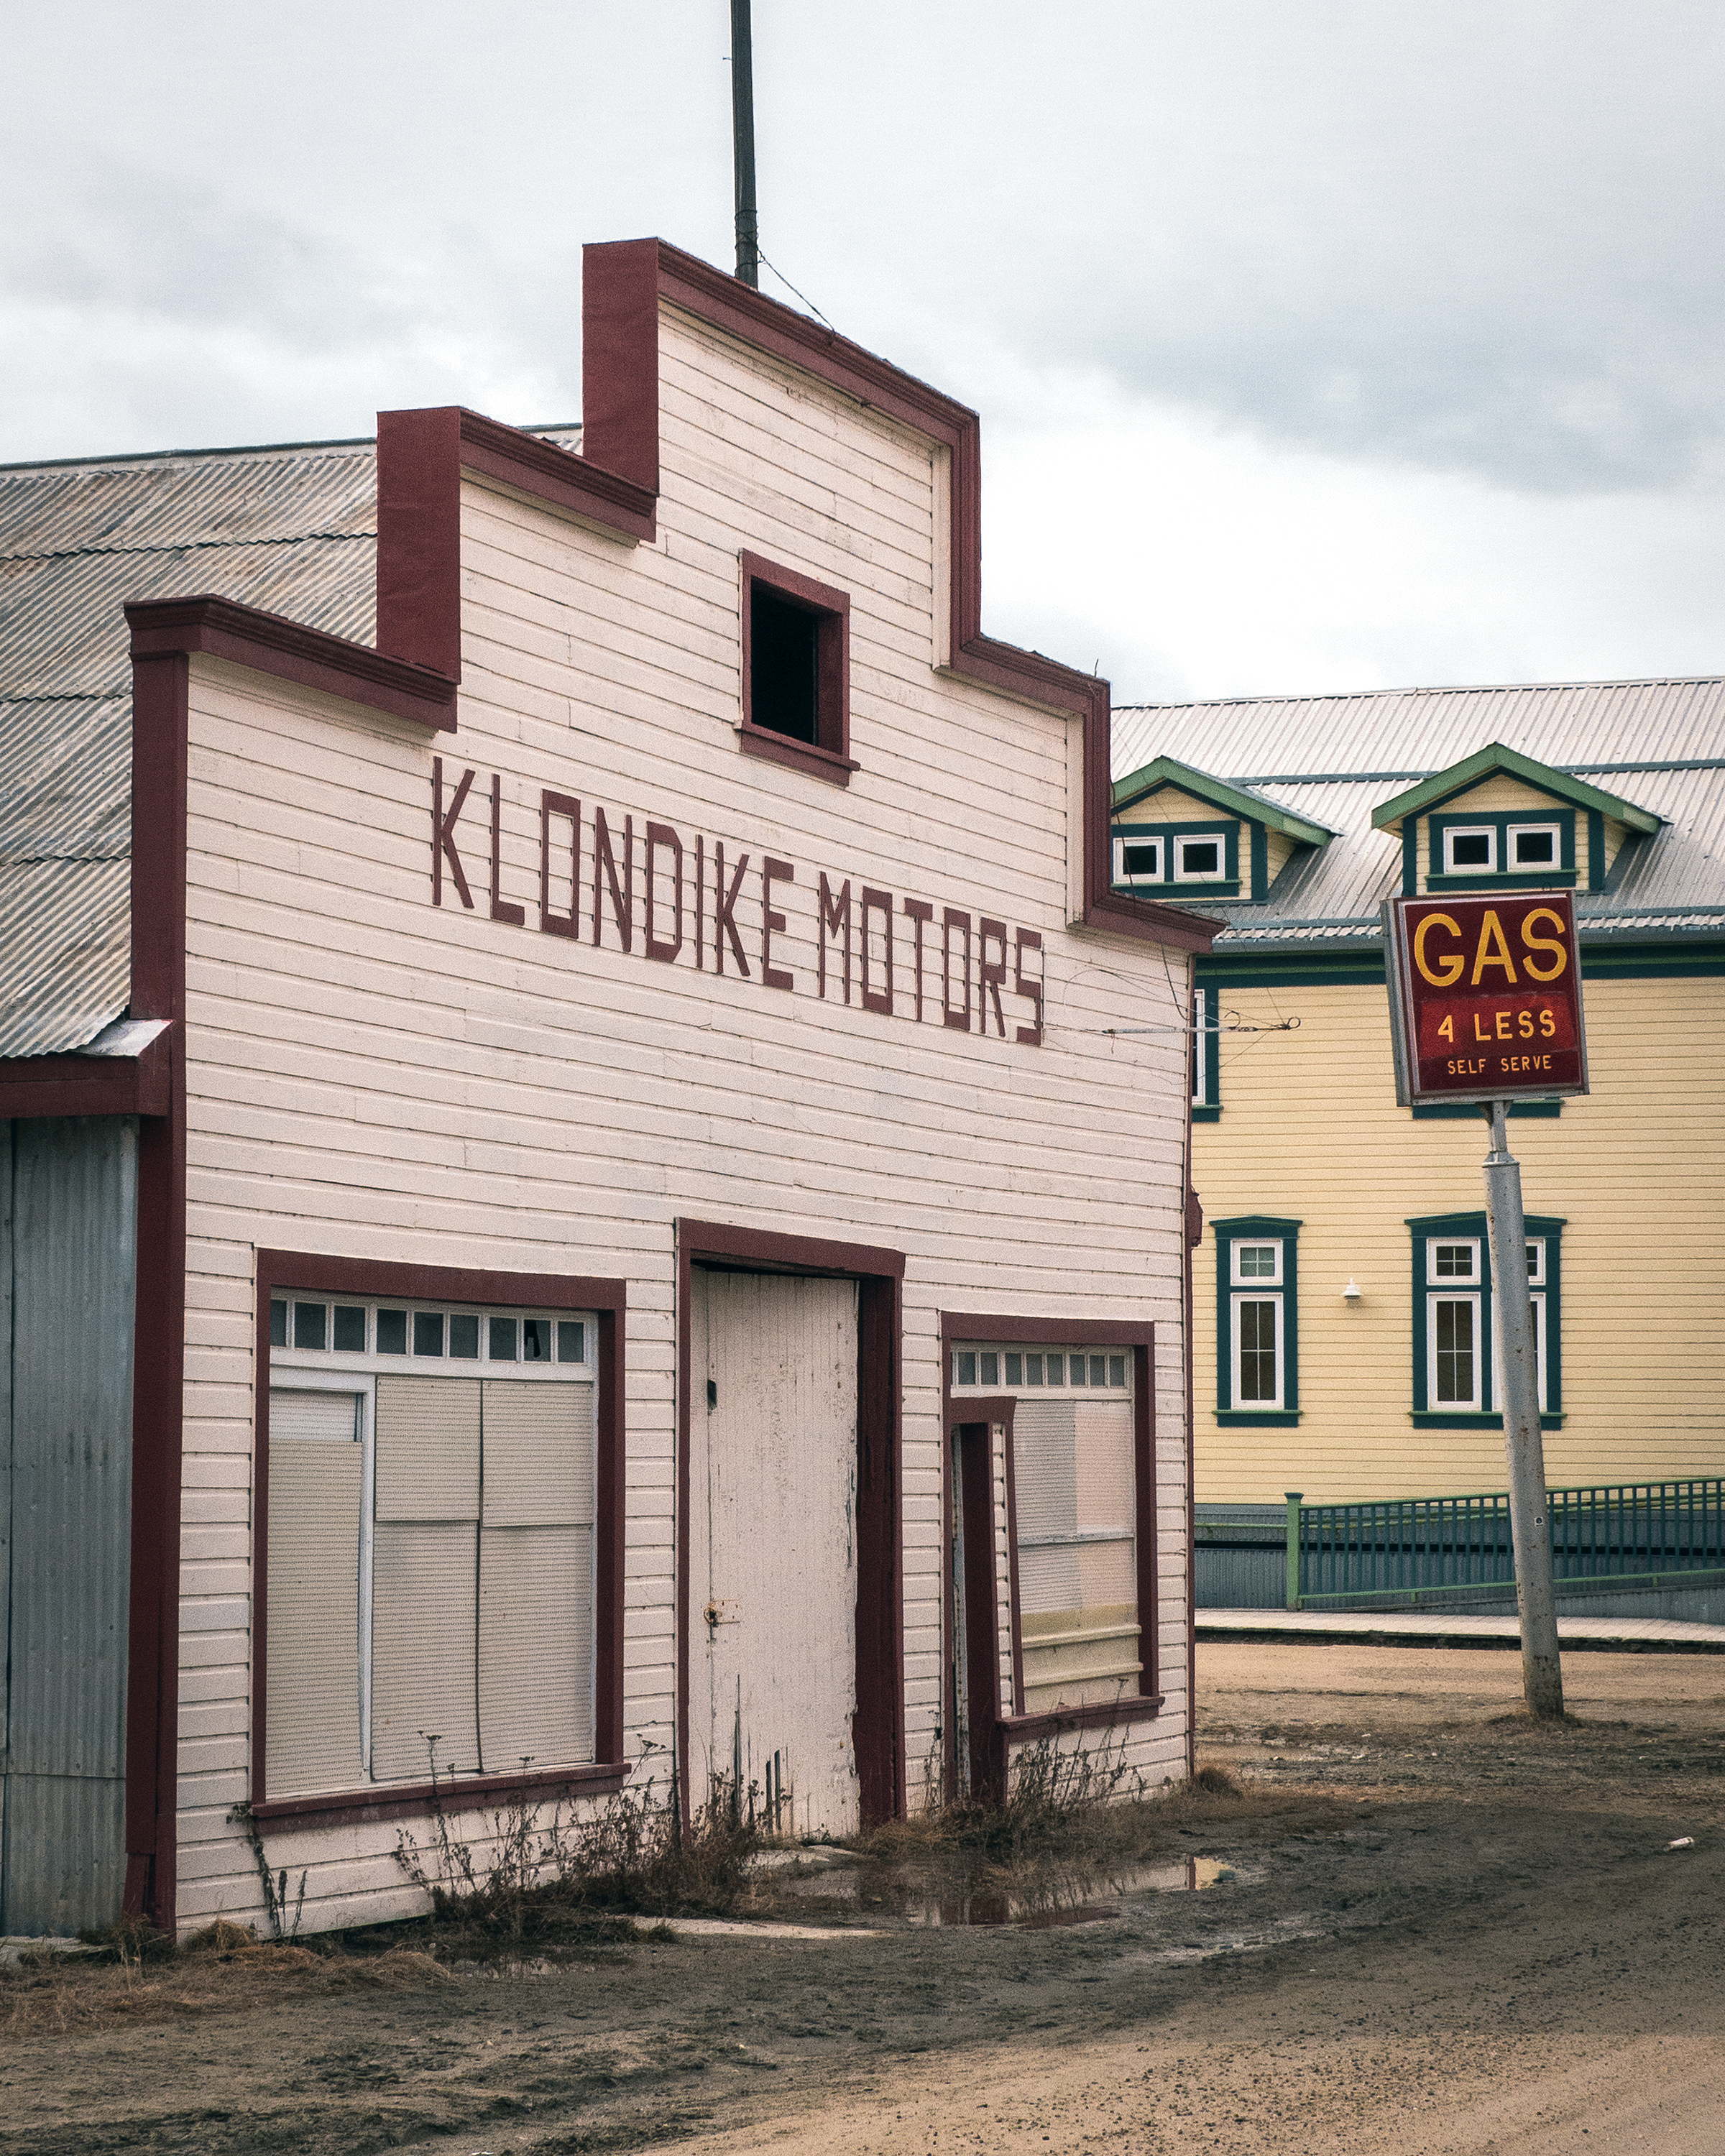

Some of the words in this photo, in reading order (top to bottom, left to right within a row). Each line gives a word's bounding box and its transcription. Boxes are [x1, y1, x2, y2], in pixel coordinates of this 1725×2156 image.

[432, 756, 794, 990] KLONDIKE
[819, 871, 1043, 1046] MOTORS
[1414, 908, 1568, 987] GAS
[1438, 1015, 1454, 1043] 4
[1474, 1010, 1556, 1041] LESS
[1448, 1059, 1487, 1074] SELF
[1501, 1055, 1552, 1072] SERVE
